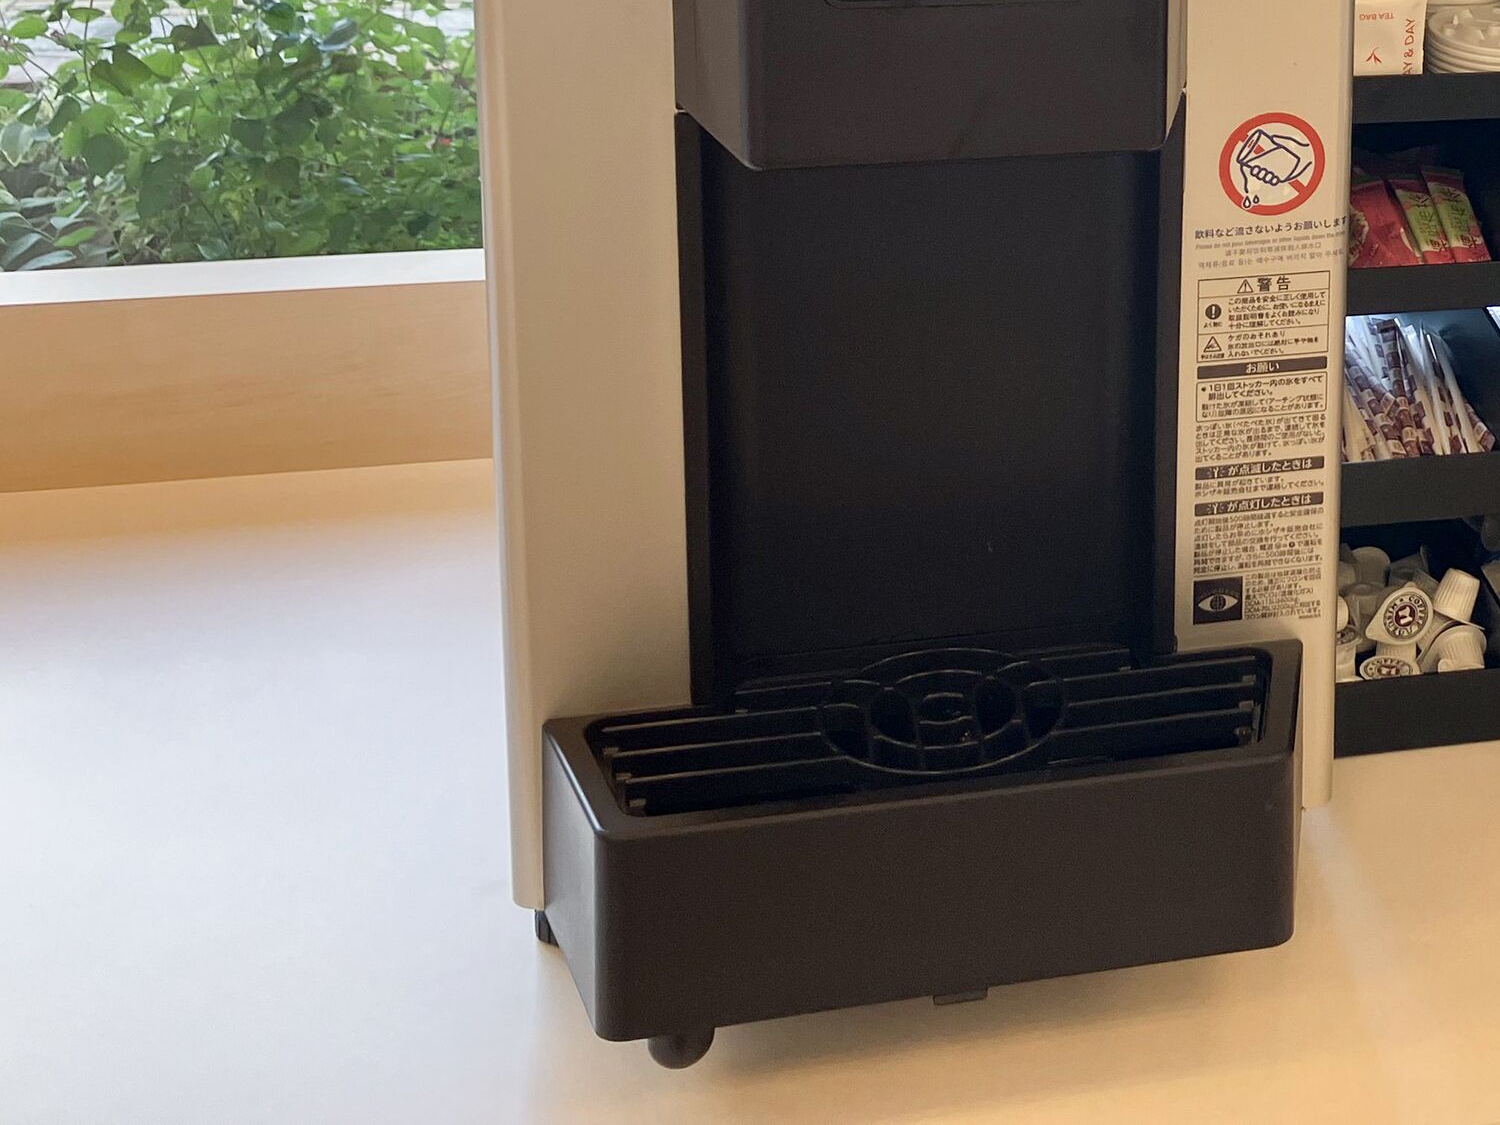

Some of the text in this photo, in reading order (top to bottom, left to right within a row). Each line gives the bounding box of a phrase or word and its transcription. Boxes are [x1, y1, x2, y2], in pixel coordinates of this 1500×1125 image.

[1359, 12, 1394, 21] TEA BAG
[1403, 18, 1416, 75] AY & DAY
[1257, 275, 1290, 292] 警告
[1246, 360, 1279, 374] お願い
